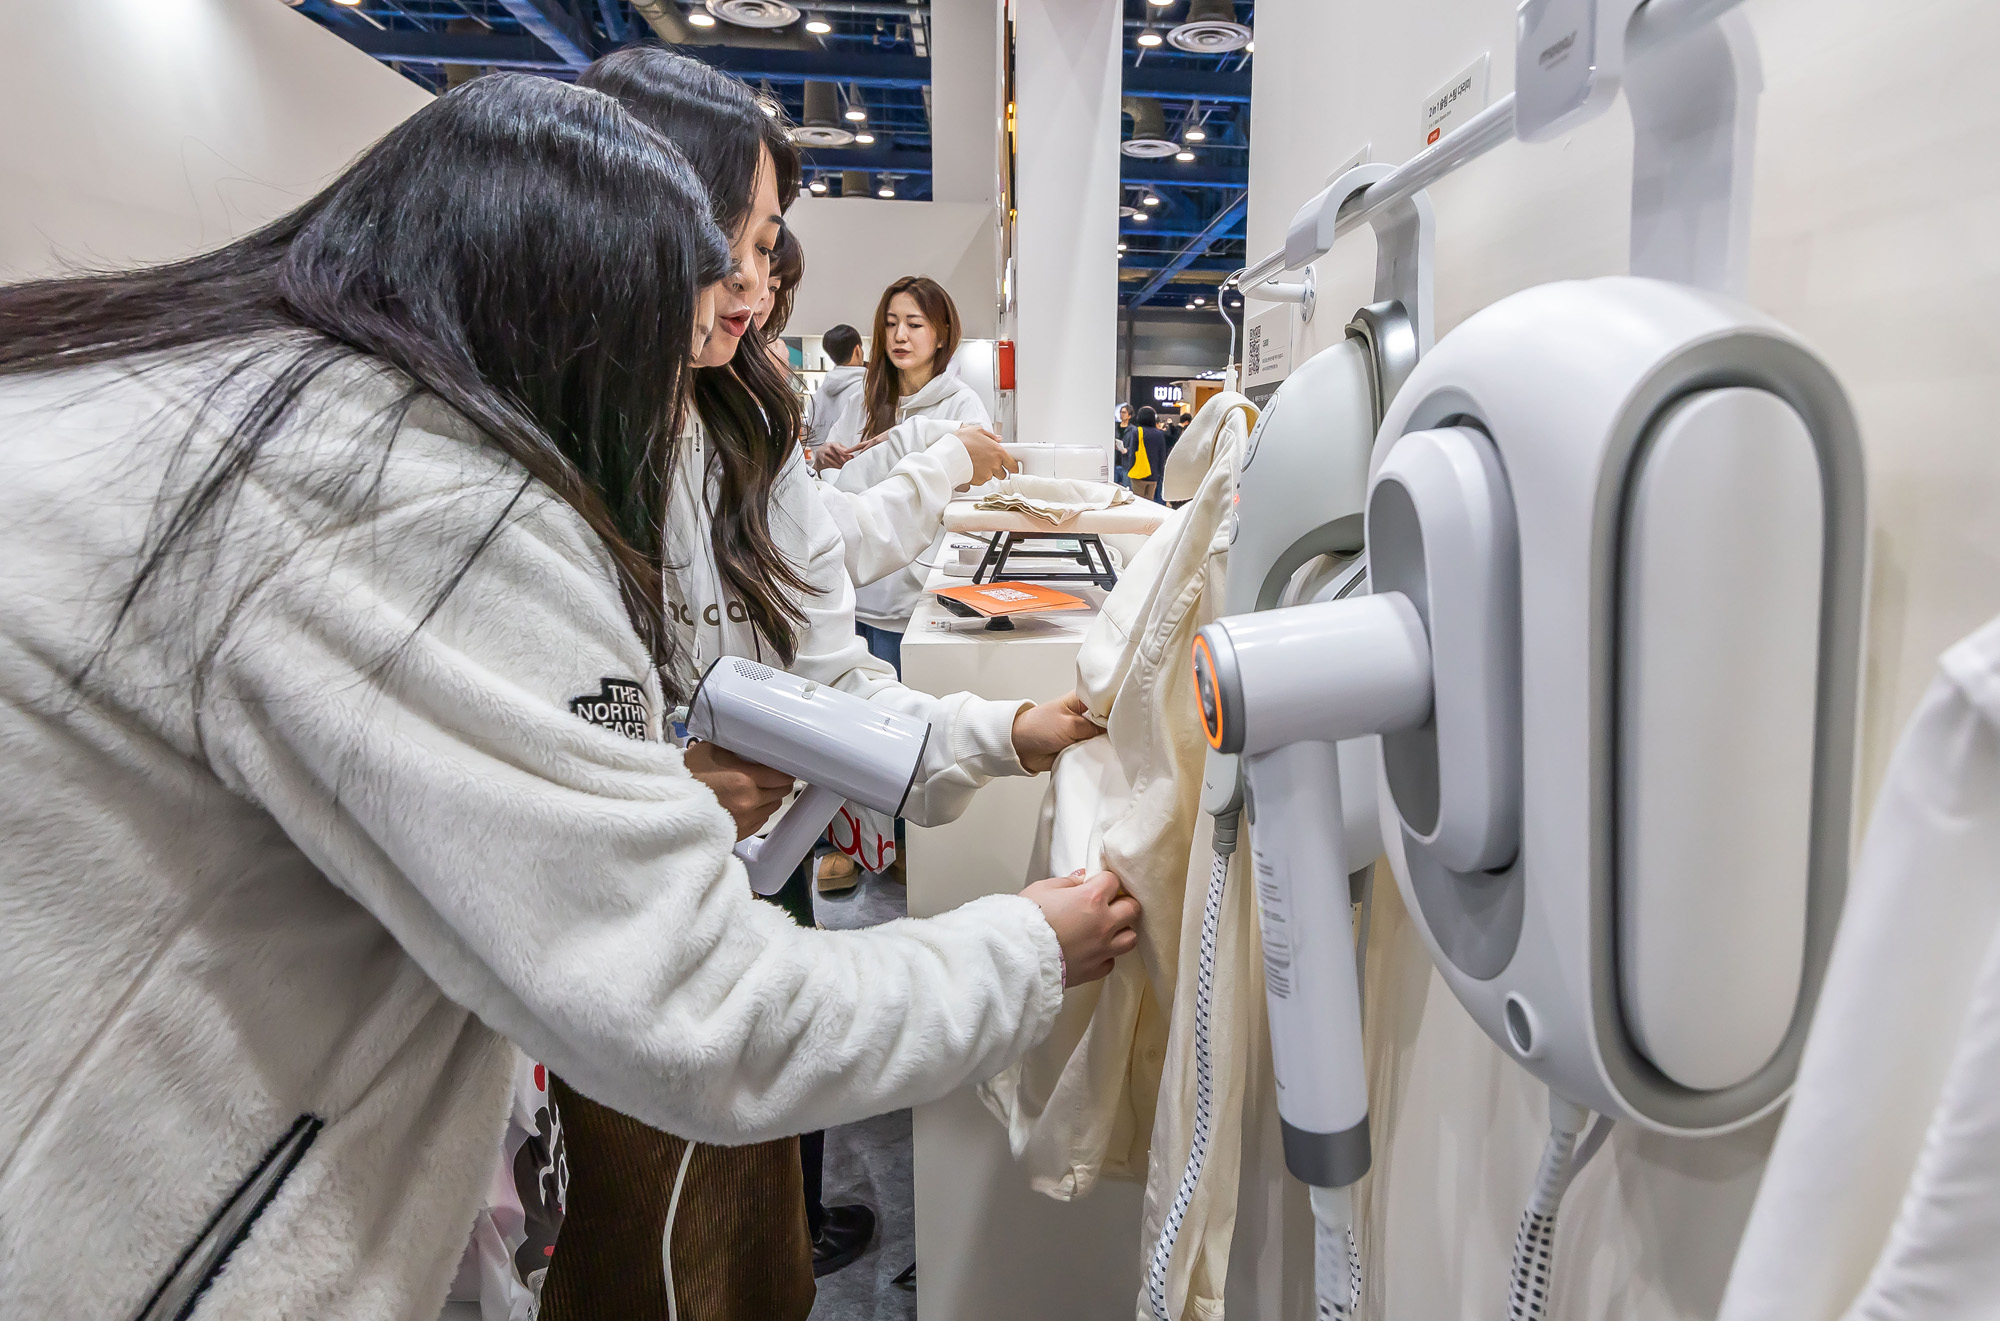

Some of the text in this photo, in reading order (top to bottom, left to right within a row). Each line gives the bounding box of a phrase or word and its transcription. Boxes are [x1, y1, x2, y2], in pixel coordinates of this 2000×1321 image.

[607, 684, 639, 704] THE
[577, 702, 641, 722] NORTH
[602, 721, 644, 740] FACE
